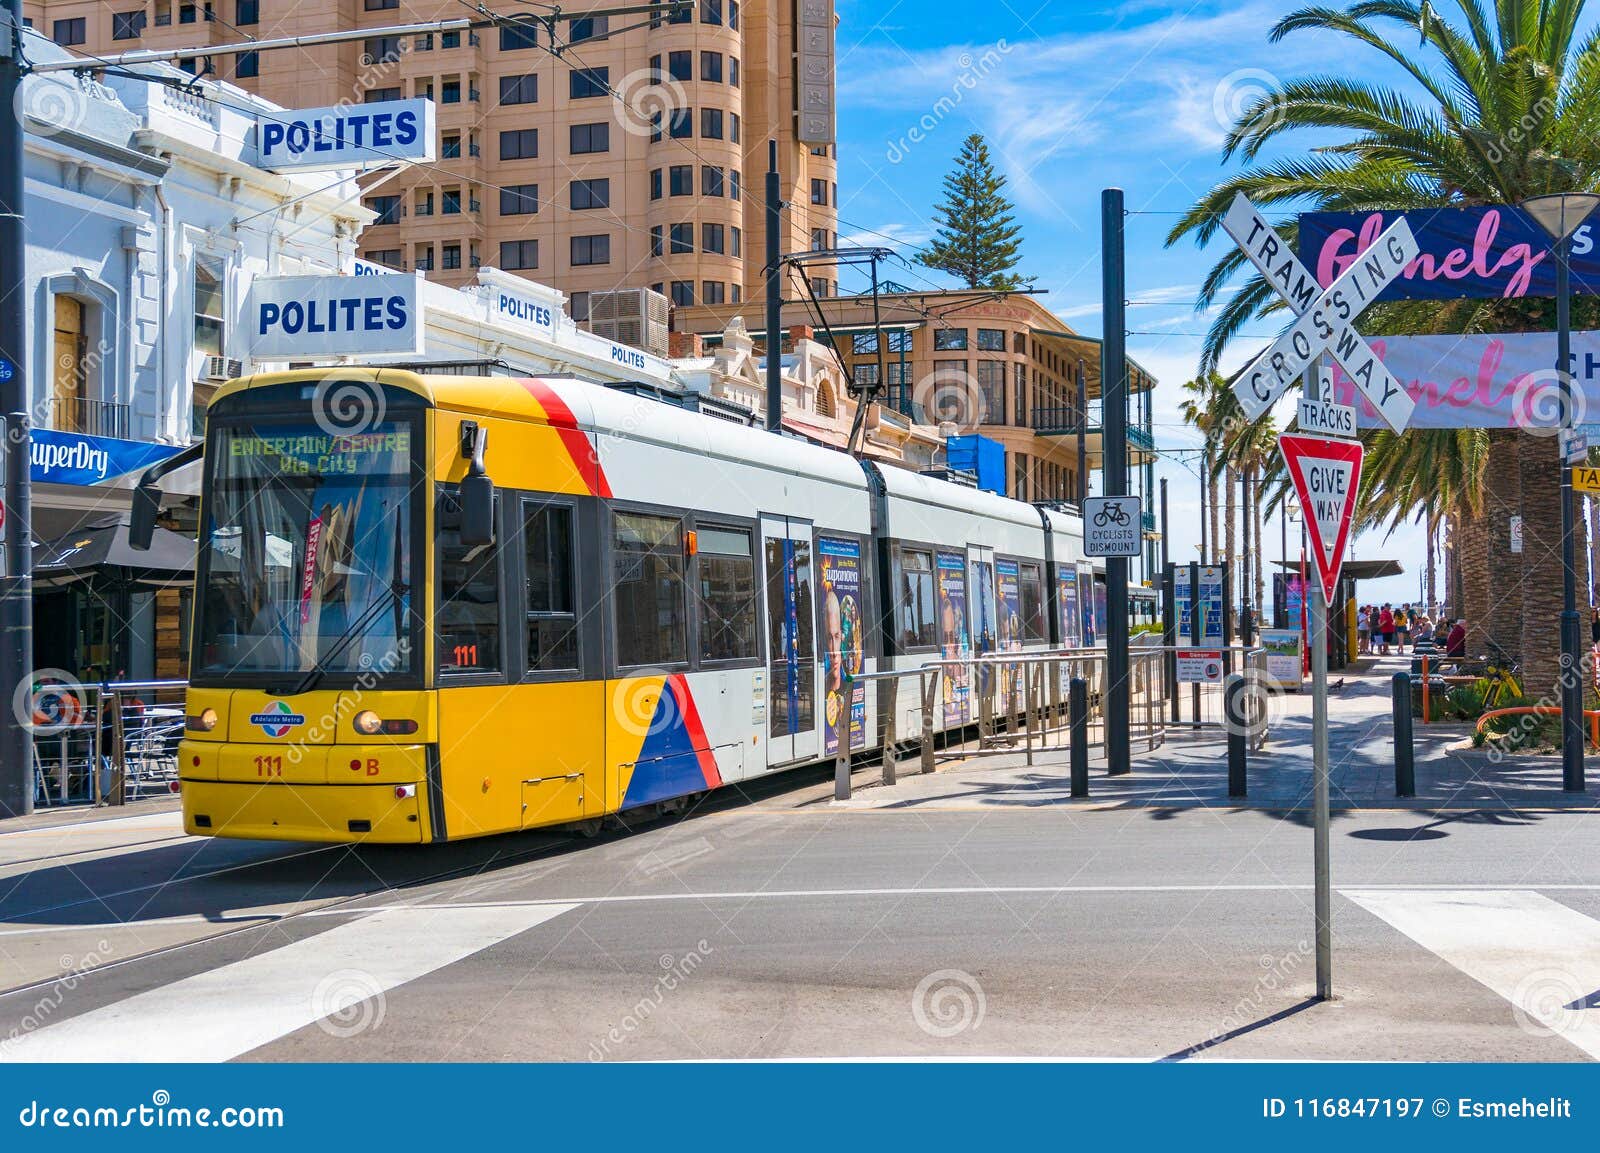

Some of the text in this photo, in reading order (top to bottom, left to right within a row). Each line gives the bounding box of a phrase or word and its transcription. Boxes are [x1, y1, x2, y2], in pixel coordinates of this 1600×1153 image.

[263, 110, 417, 156] POLITES
[1317, 210, 1547, 298] Glnelg
[259, 295, 407, 335] POLITES
[500, 294, 551, 327] POLITES
[1251, 236, 1405, 403] CROSSING
[611, 346, 645, 369] POLITES
[1322, 377, 1331, 402] 2
[1331, 339, 1548, 425] lnelg
[1302, 403, 1352, 431] TRACKS
[280, 456, 357, 473] Via City
[1310, 466, 1345, 494] GIVE
[1317, 499, 1341, 521] WAY
[1090, 542, 1135, 552] DISMOUNT
[1092, 530, 1133, 540] CYCLISTS
[454, 645, 477, 666] 111
[254, 715, 302, 724] Adelaide Metro
[254, 755, 282, 777] 111
[366, 758, 380, 777] B
